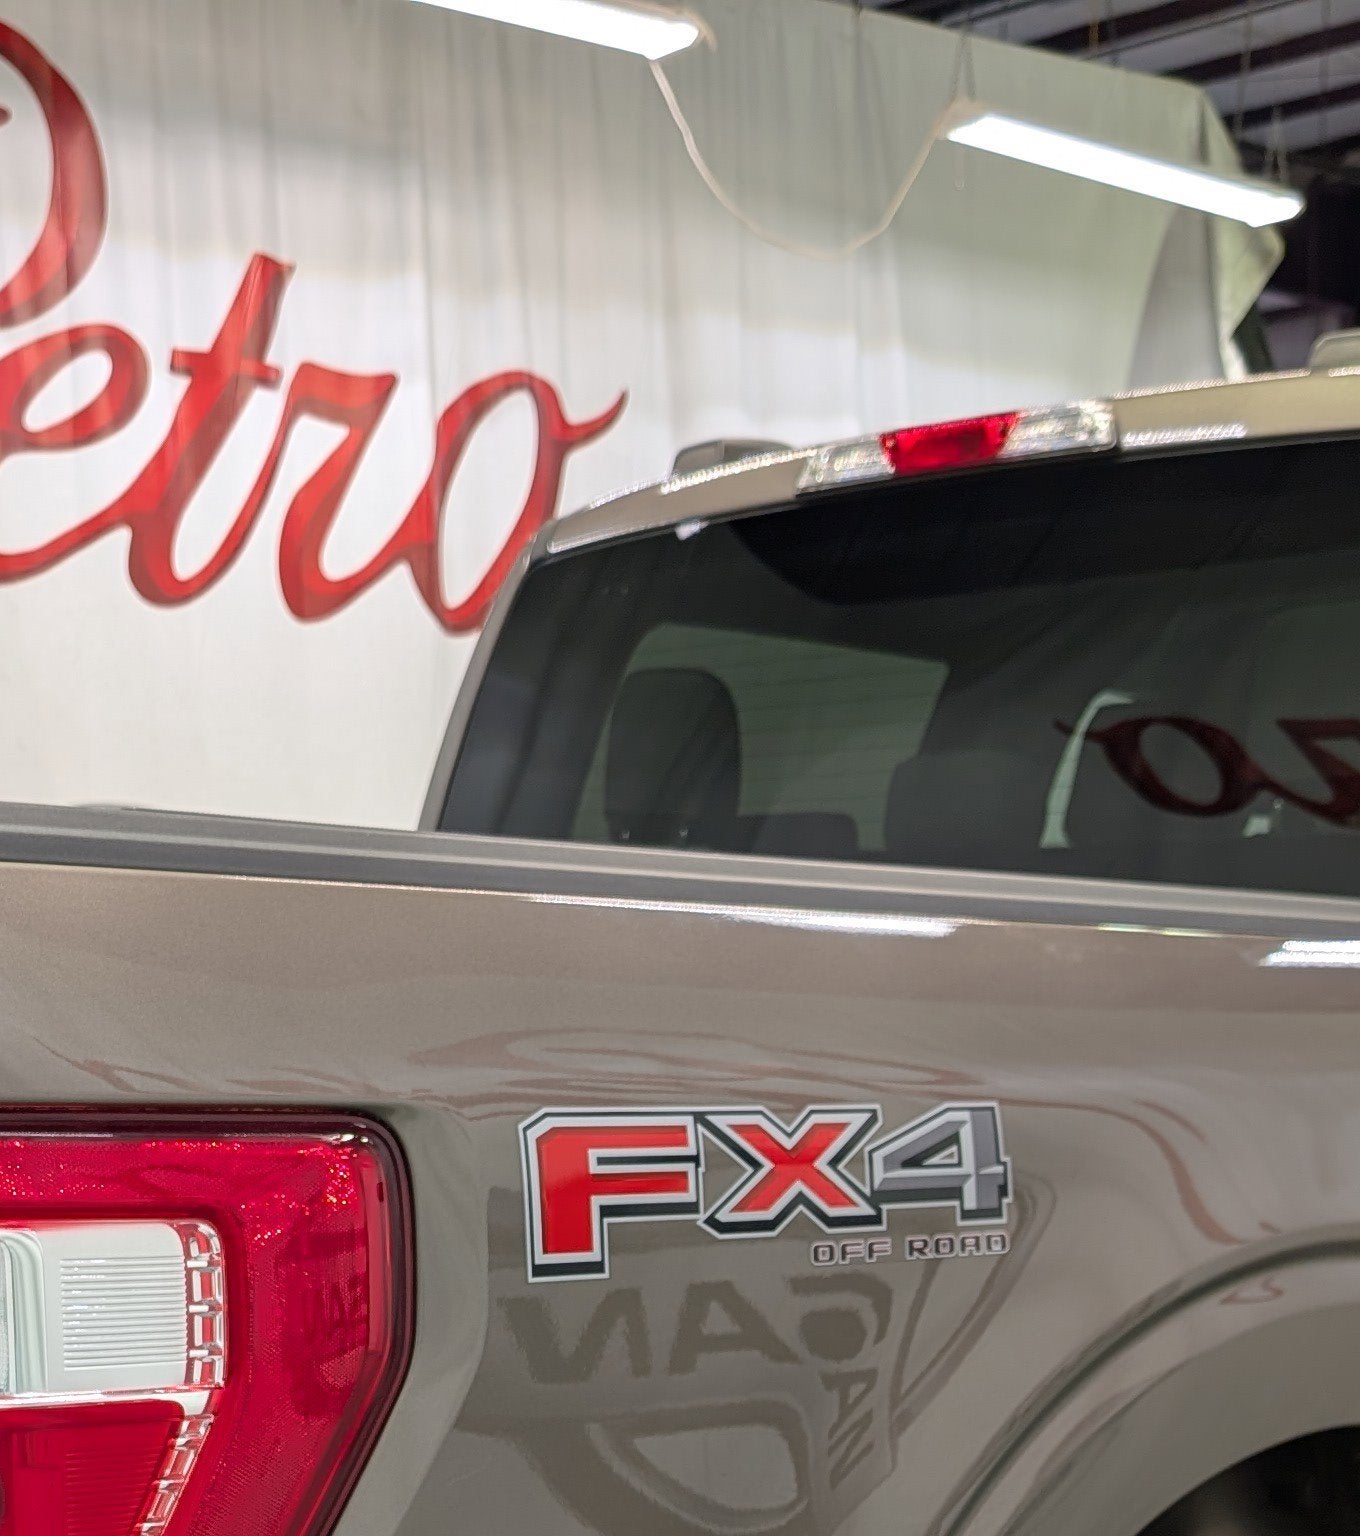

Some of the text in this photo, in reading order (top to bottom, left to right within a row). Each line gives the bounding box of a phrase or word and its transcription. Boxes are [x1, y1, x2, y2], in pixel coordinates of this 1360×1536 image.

[518, 1101, 1013, 1283] FX4
[809, 1232, 1012, 1267] OFF ROAD
